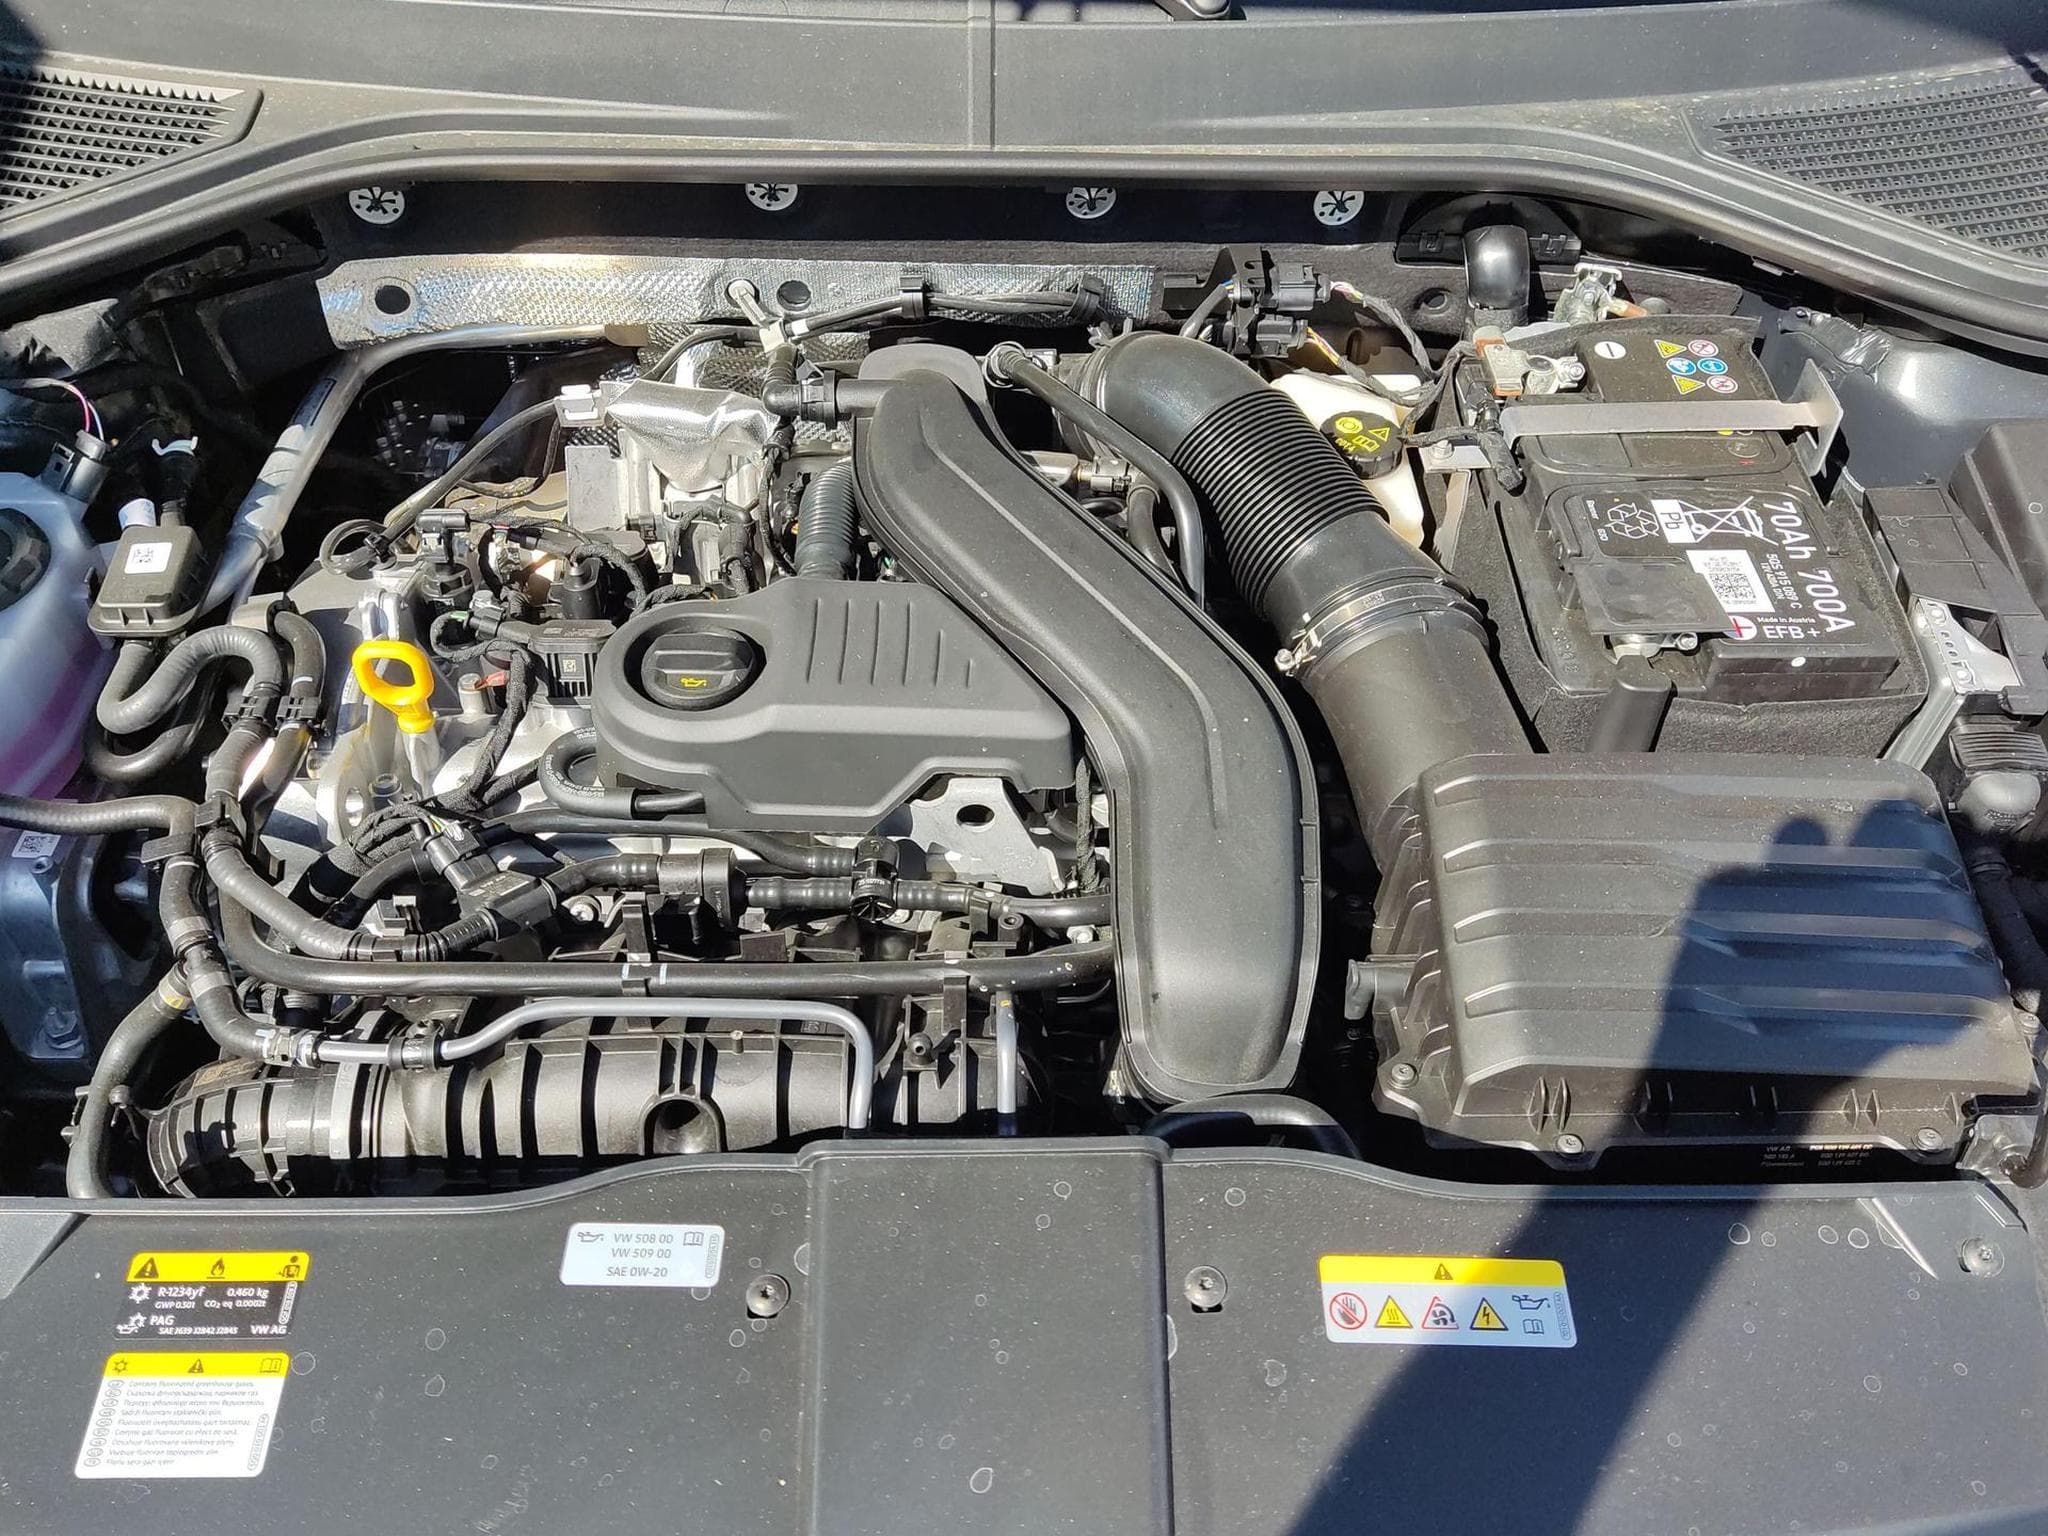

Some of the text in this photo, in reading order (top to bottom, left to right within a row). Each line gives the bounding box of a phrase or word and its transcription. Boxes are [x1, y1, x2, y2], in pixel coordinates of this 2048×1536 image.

[1660, 511, 1685, 530] Pb
[1762, 501, 1857, 633] 70Ah 700A
[1774, 570, 1793, 587] 915
[1790, 602, 1803, 610] C
[1762, 625, 1805, 639] EFB
[613, 1233, 674, 1244] VW 508 00
[611, 1248, 672, 1259] VW 509 00
[606, 1266, 668, 1278] SAE 0W-20
[158, 1286, 206, 1300] R-1234yf
[256, 1287, 270, 1299] kg
[155, 1301, 175, 1309] GWP
[222, 1301, 233, 1309] eq
[150, 1314, 176, 1326] PAG
[158, 1327, 174, 1335] SAE
[250, 1325, 288, 1335] VW AG
